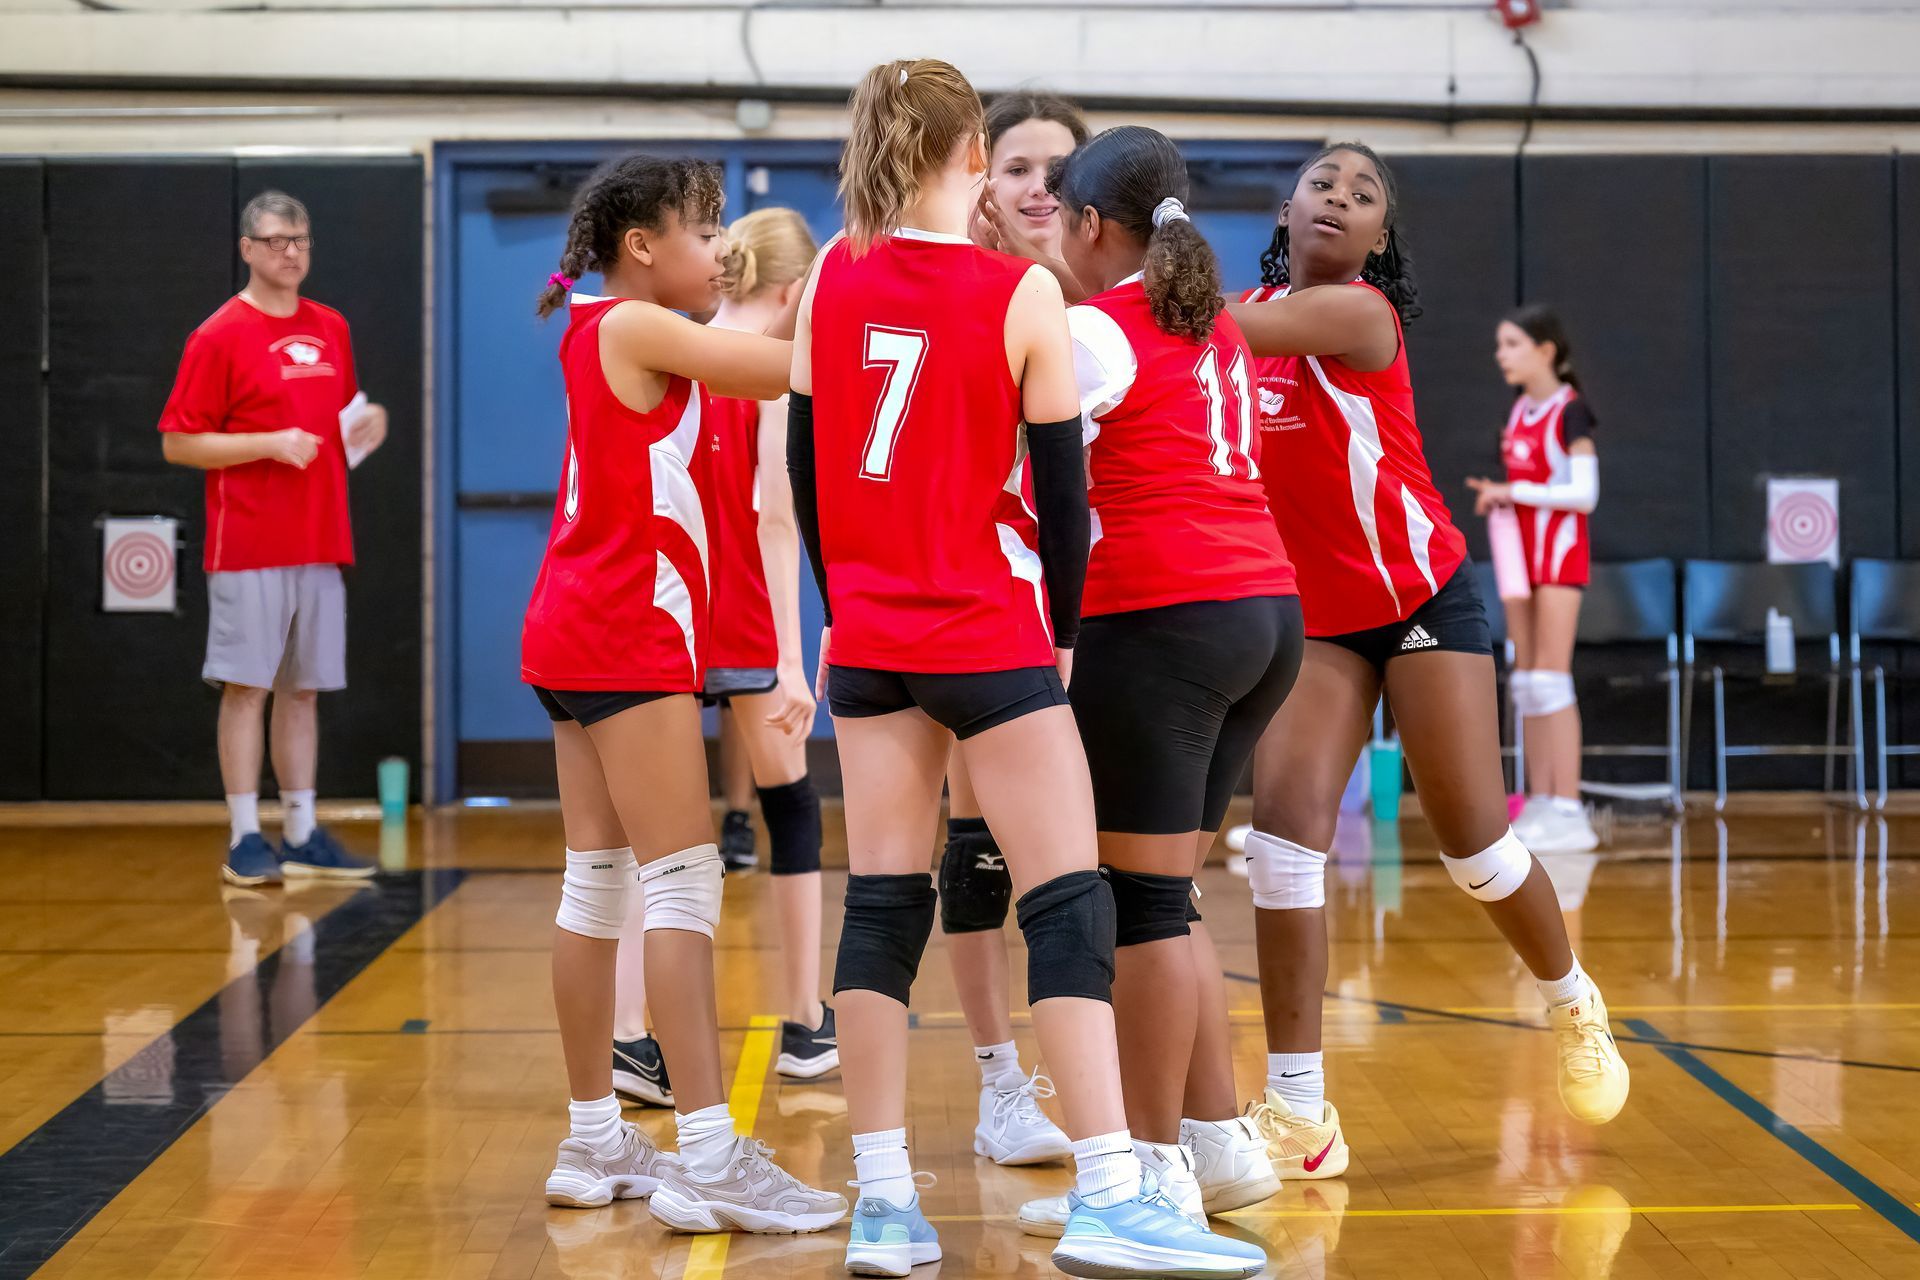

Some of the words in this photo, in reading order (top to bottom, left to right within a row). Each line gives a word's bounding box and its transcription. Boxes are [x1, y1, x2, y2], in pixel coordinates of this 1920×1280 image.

[858, 323, 930, 482] 7
[1193, 343, 1260, 480] 11
[1401, 638, 1439, 650] adidas
